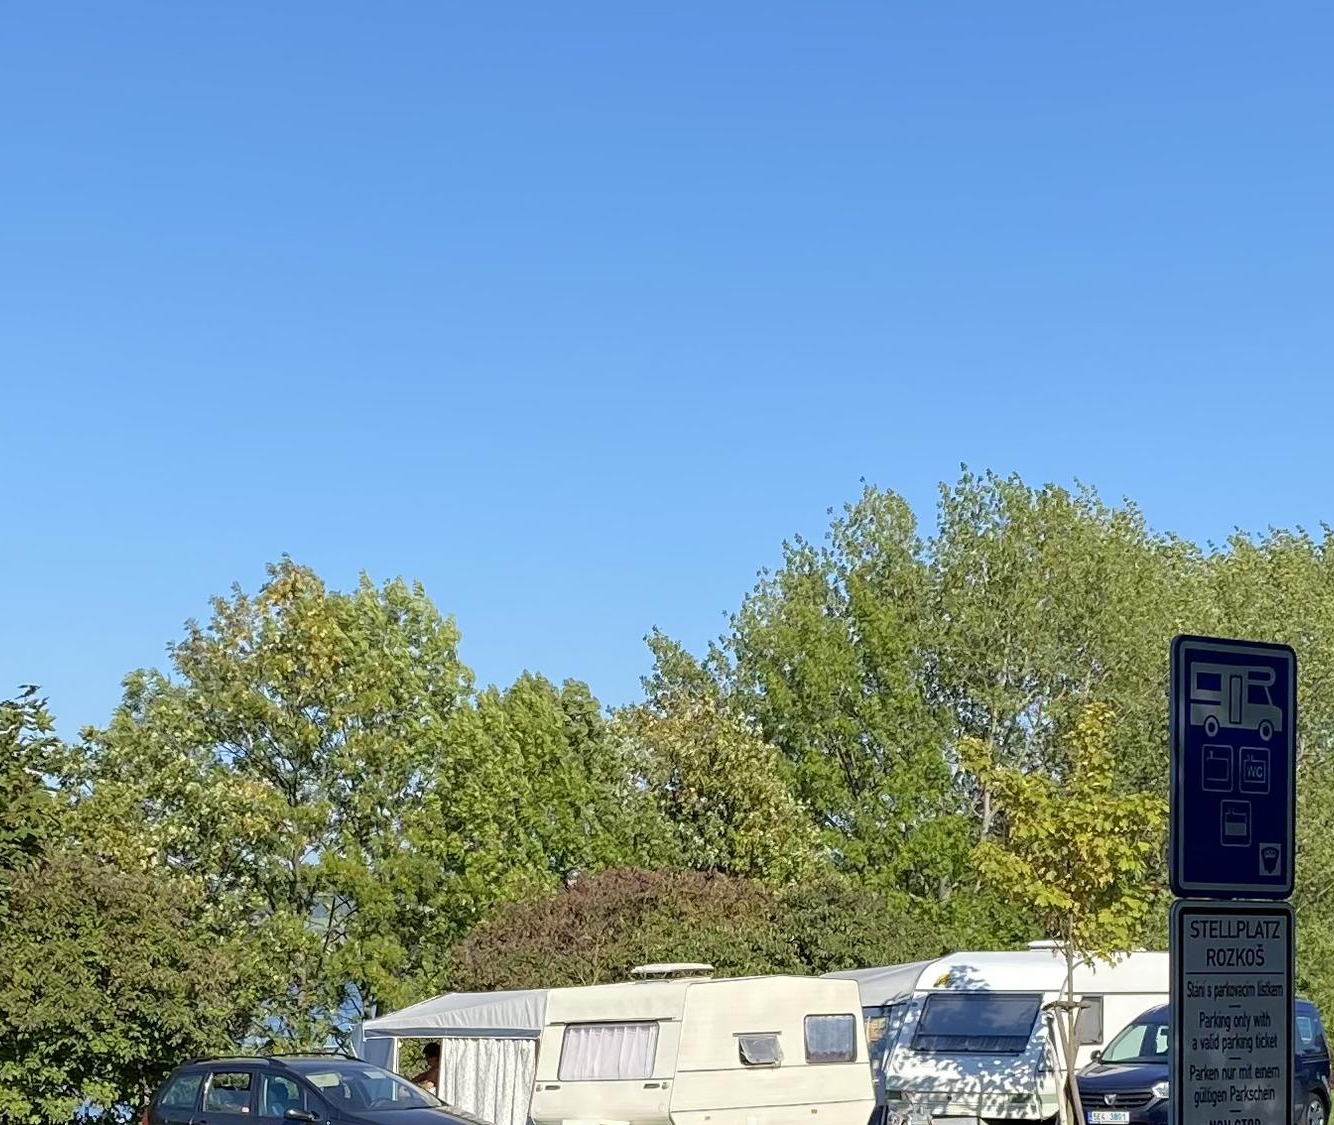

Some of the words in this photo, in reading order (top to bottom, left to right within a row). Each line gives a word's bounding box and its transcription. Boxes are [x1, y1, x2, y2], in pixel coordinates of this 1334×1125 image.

[1247, 766, 1263, 778] WC
[1190, 920, 1281, 939] STELLPLATZ
[1206, 943, 1265, 967] ROZKOŠ
[1207, 985, 1212, 998] s
[1199, 1011, 1231, 1032] Parking
[1233, 1011, 1251, 1032] only
[1253, 1009, 1271, 1027] with
[1192, 1038, 1198, 1051] a
[1200, 1034, 1219, 1050] valid
[1222, 1033, 1253, 1053] parking
[1255, 1033, 1278, 1049] ticket
[1190, 1064, 1219, 1081] Parken
[1222, 1067, 1237, 1080] nur
[1239, 1065, 1253, 1079] mit
[1255, 1065, 1280, 1079] einem
[1194, 1086, 1227, 1108] gültigen
[1229, 1084, 1276, 1102] Parkschein
